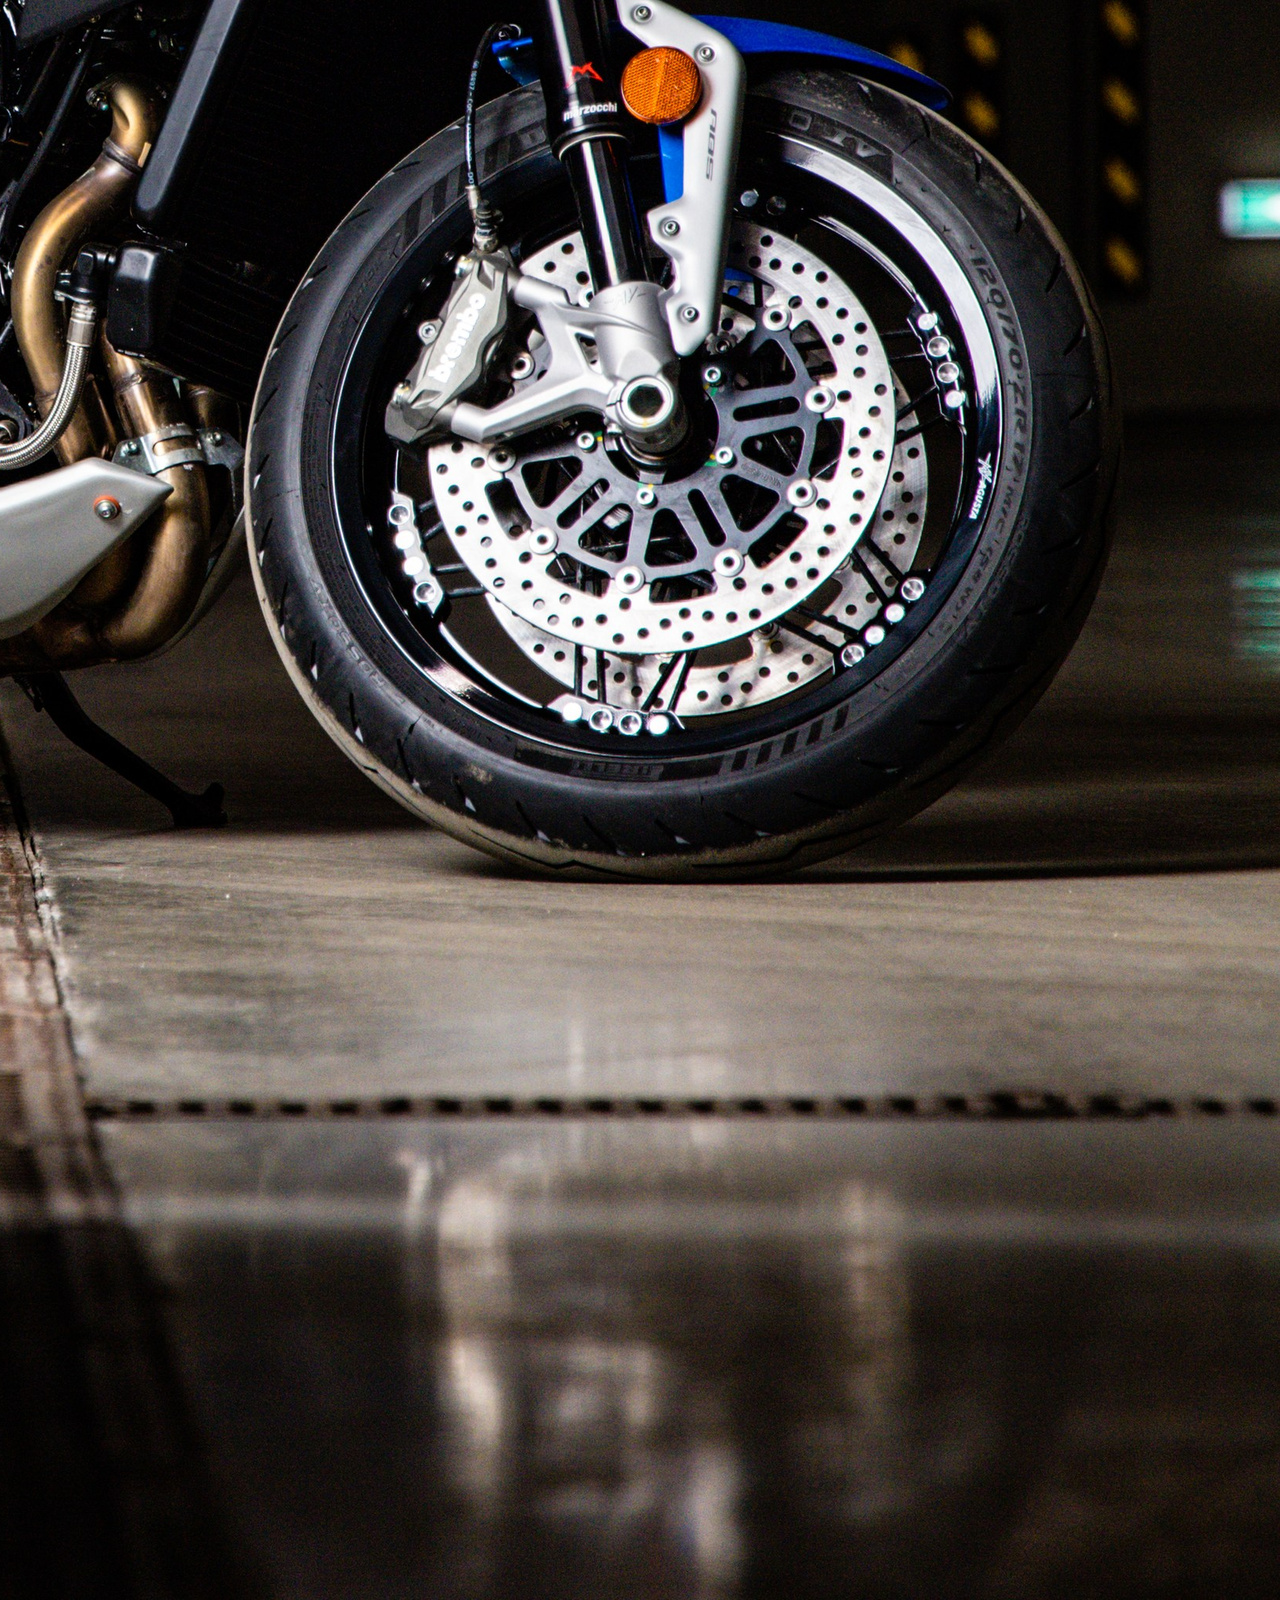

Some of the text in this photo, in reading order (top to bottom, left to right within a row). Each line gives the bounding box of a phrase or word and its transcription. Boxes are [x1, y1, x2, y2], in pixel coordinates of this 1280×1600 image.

[563, 102, 618, 122] marzocchi
[705, 108, 718, 181] ABS
[428, 292, 487, 384] brembo
[970, 252, 1025, 371] 120/70
[1010, 379, 1027, 435] ZR
[968, 479, 987, 520] AGUSTA
